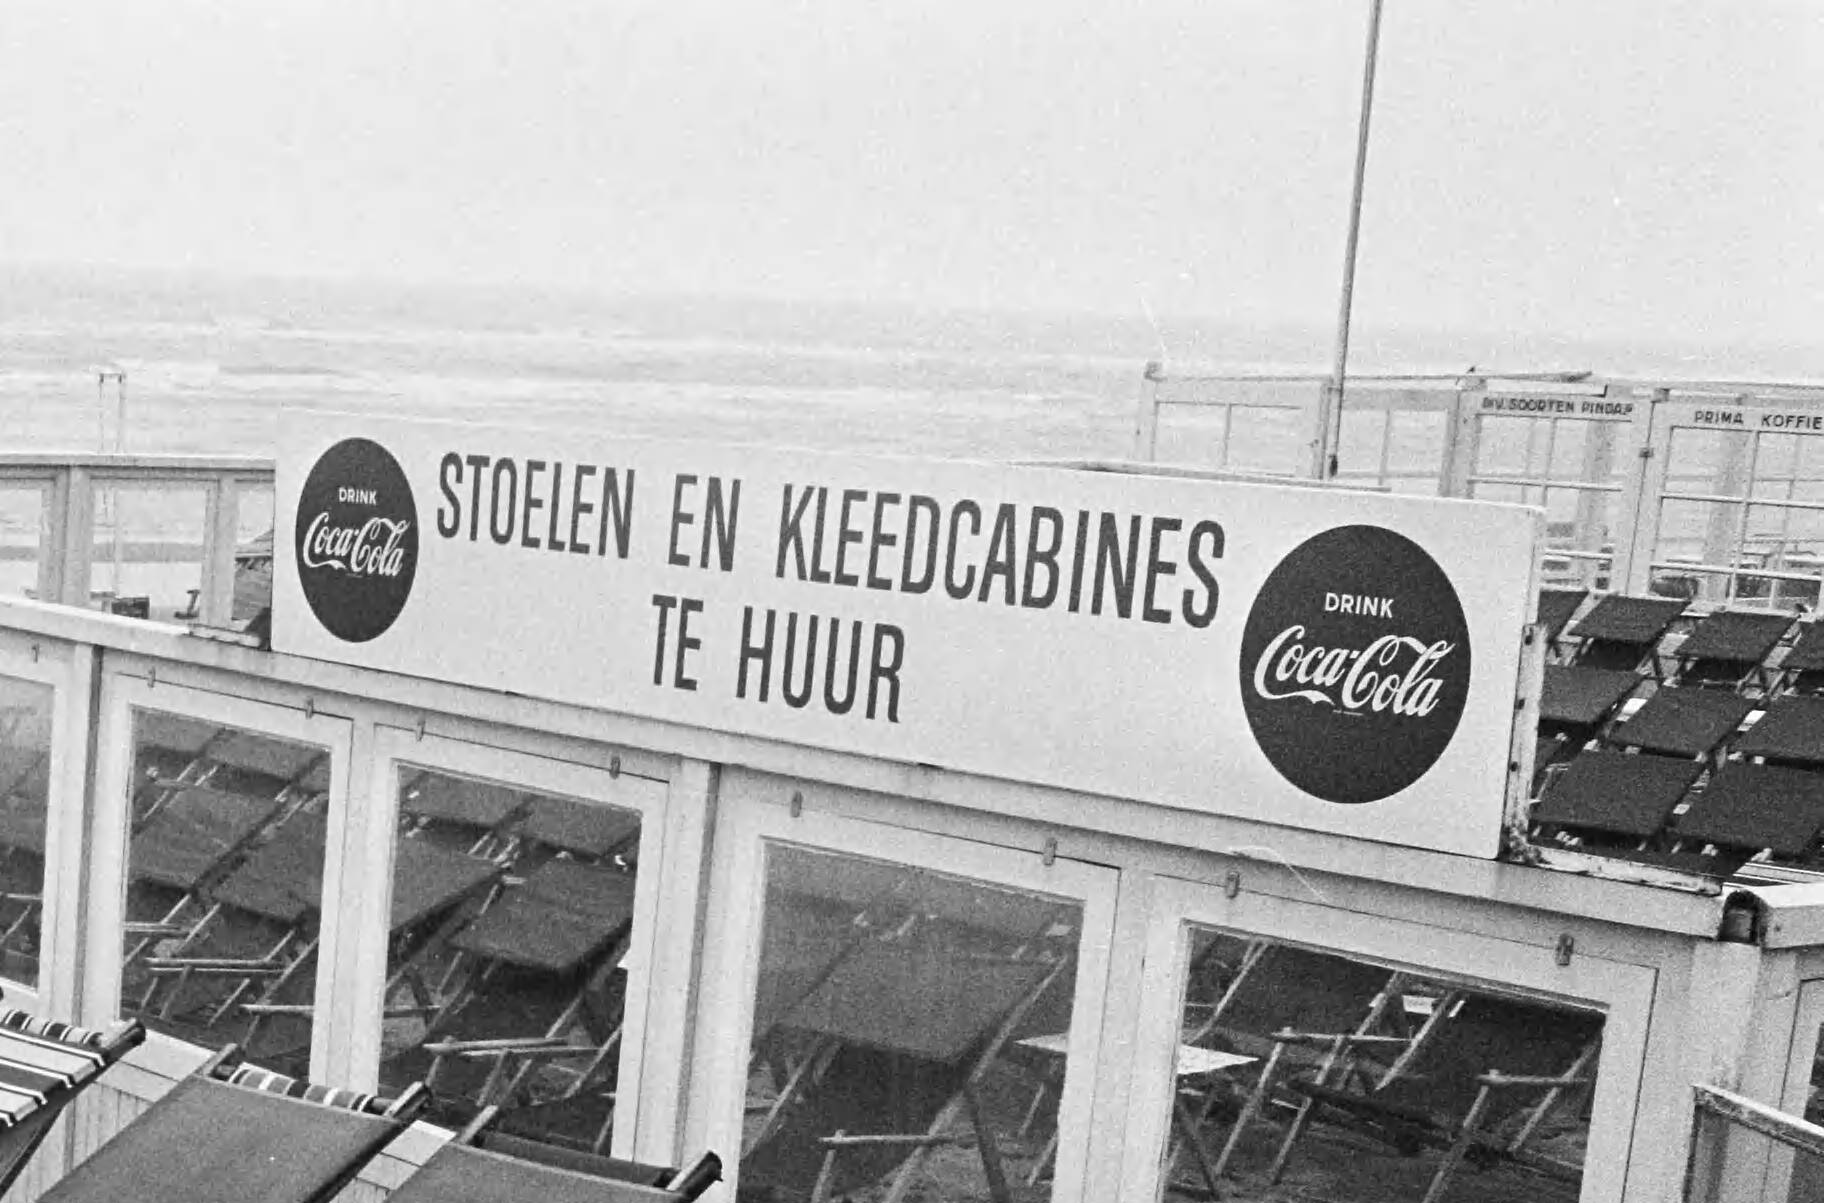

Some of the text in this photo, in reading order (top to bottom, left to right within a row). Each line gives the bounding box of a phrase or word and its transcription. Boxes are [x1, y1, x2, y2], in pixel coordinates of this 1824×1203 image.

[1508, 398, 1575, 413] SOORTEN
[1694, 410, 1823, 430] PRIMA KOFFIE
[338, 487, 377, 505] DRINK
[303, 511, 411, 577] Coca-Cola
[437, 452, 1225, 629] STOELEN EN KLEEDCABINES
[1324, 592, 1394, 619] DRINK
[652, 594, 905, 724] TE HUUR
[1253, 624, 1456, 717] Coca-Cola
